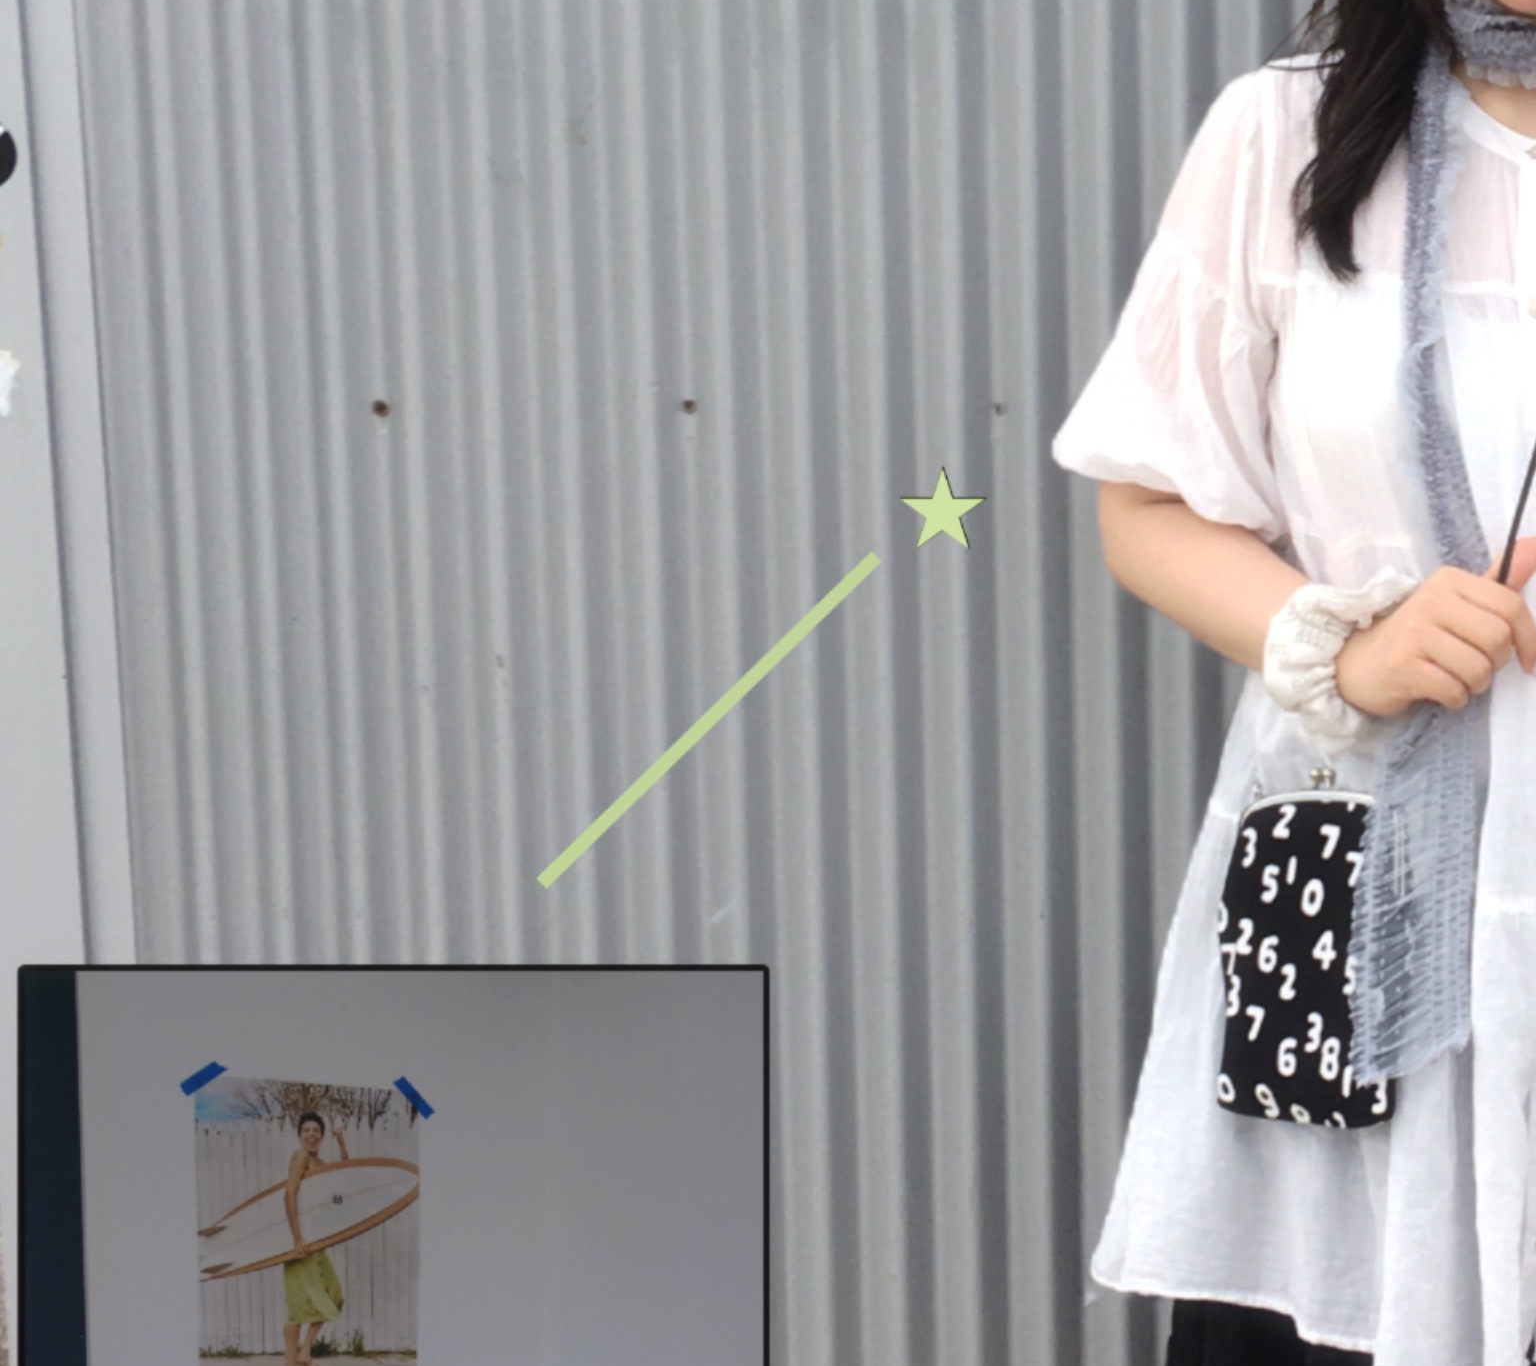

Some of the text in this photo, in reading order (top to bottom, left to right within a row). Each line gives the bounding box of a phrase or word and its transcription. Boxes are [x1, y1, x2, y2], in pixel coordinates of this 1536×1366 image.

[1272, 803, 1297, 839] 2
[1242, 826, 1258, 868] 3
[1320, 823, 1341, 860] 7
[1260, 864, 1280, 904] 5
[1286, 855, 1298, 885] 1
[1345, 850, 1364, 887] 7
[1301, 877, 1325, 918] 0
[1238, 917, 1253, 955] 2
[1257, 934, 1279, 974] 6
[1311, 929, 1337, 971] 4
[1225, 974, 1241, 1018] 3
[1278, 962, 1297, 1001] 2
[1245, 1004, 1266, 1042] 7
[1304, 1011, 1324, 1054] 3
[1276, 1036, 1298, 1077] 6
[1319, 1036, 1341, 1081] 8
[1216, 1072, 1236, 1104] 0
[1253, 1082, 1281, 1120] 9
